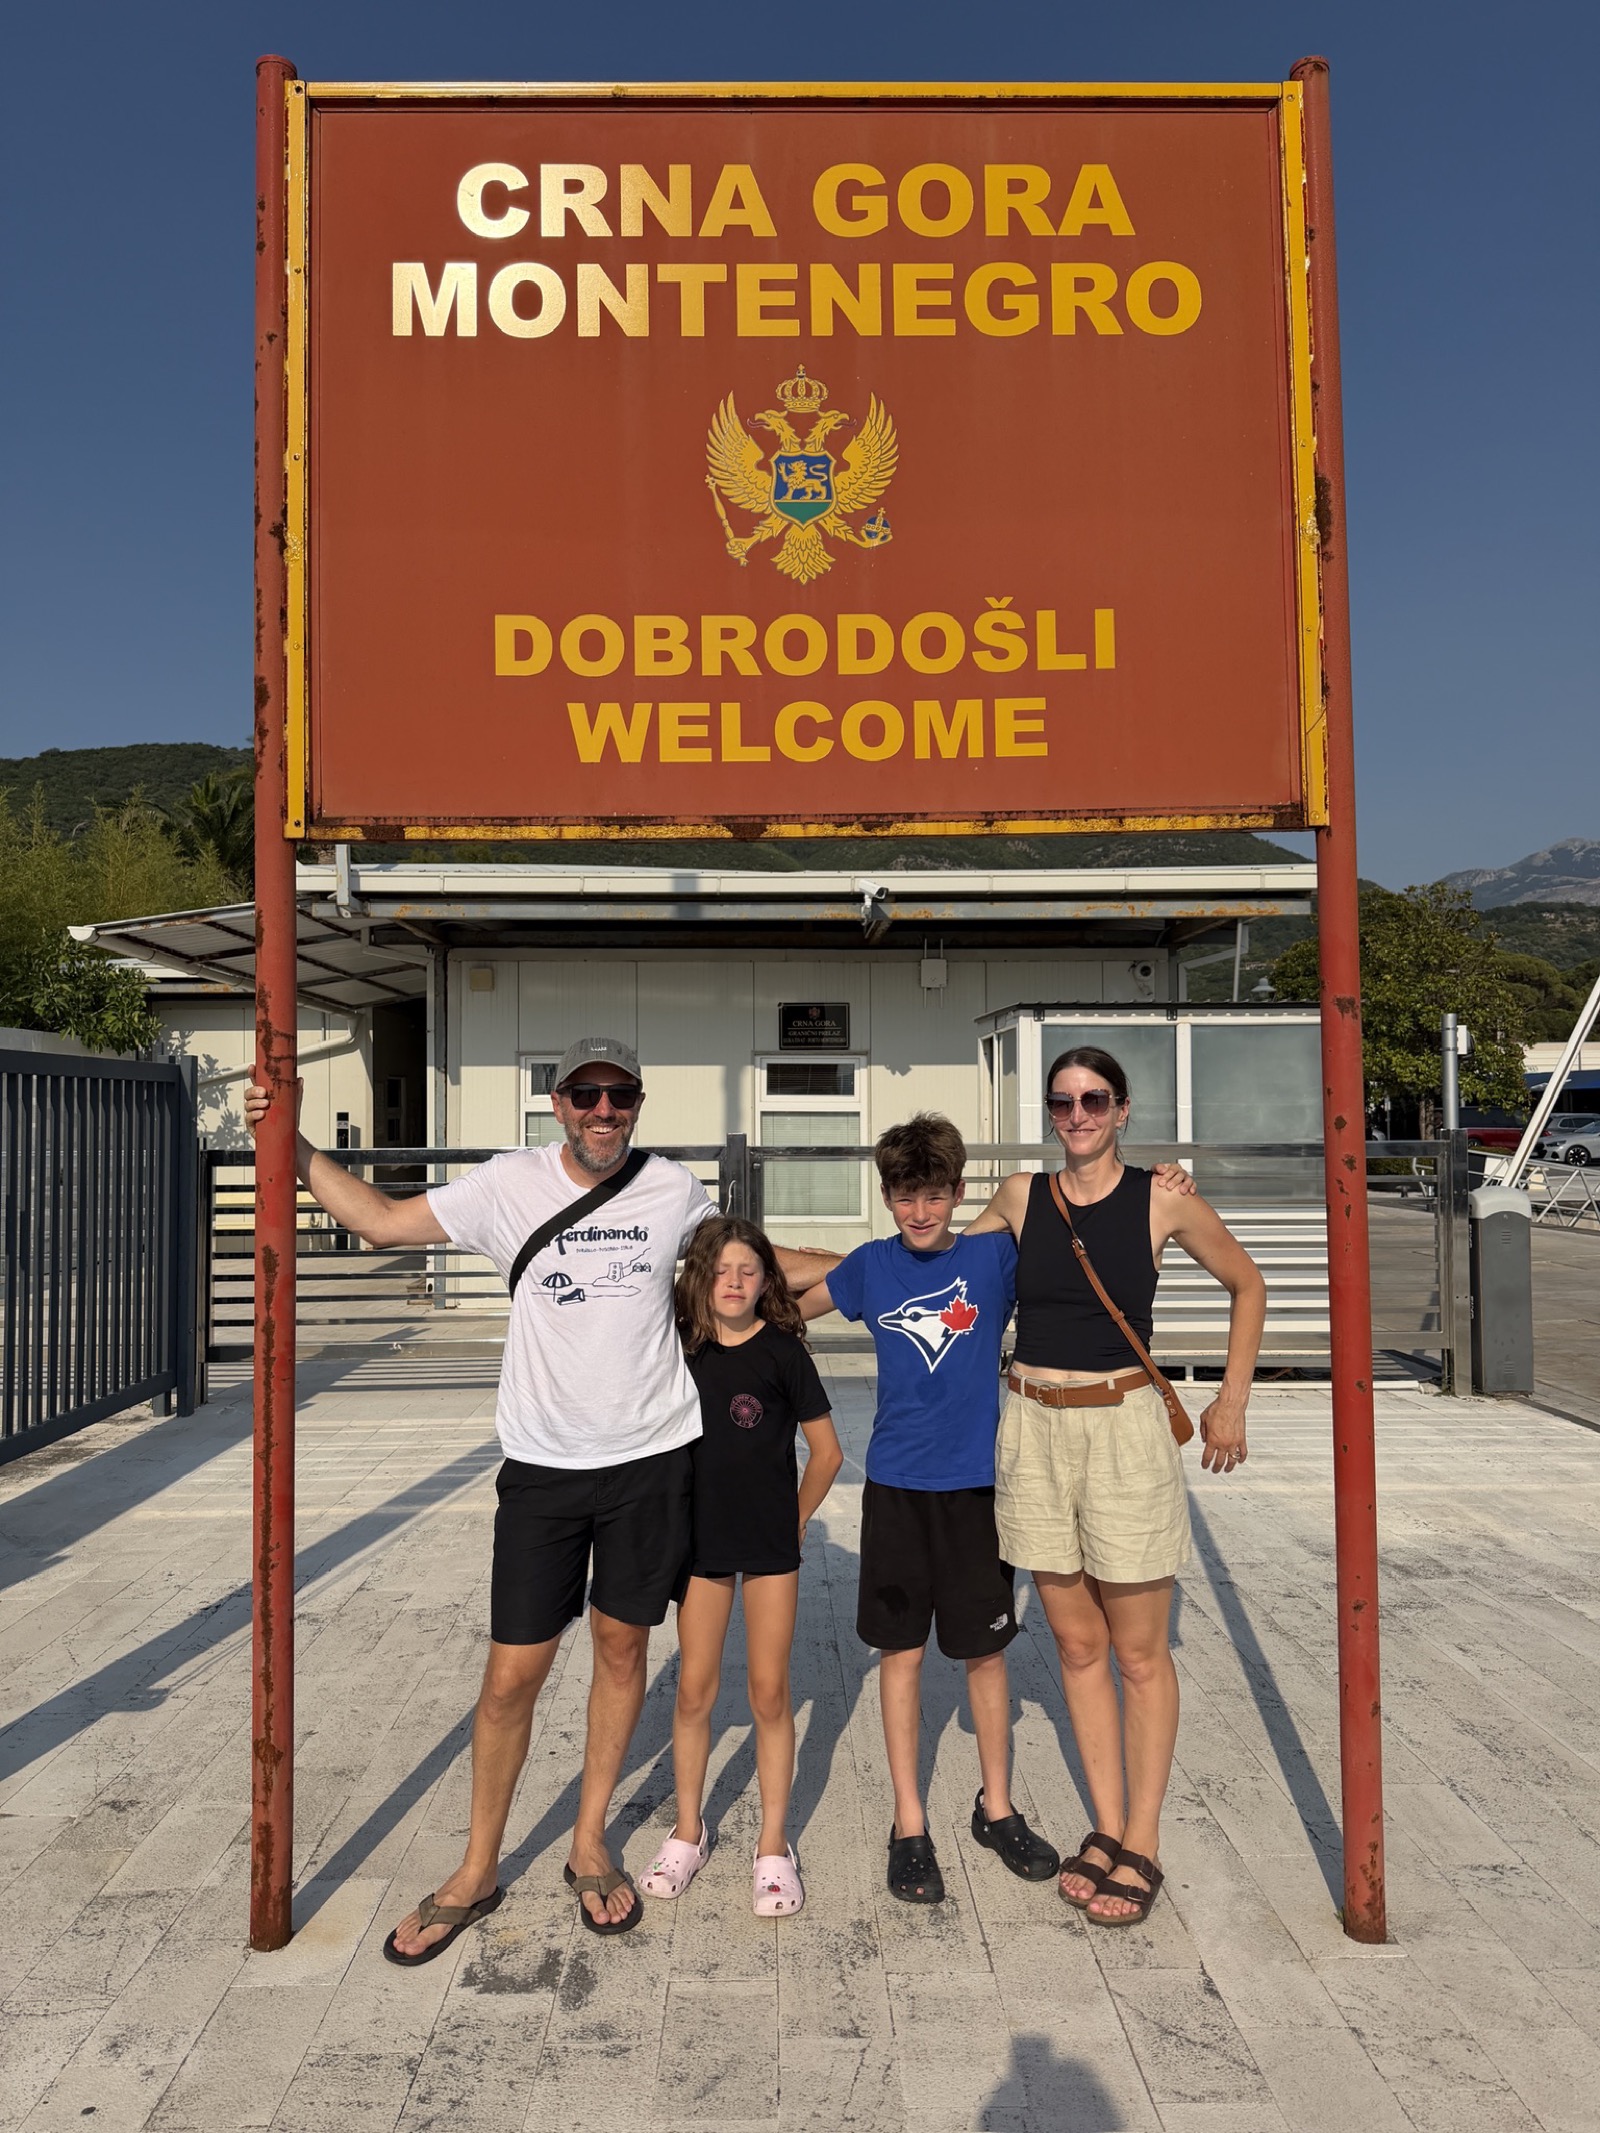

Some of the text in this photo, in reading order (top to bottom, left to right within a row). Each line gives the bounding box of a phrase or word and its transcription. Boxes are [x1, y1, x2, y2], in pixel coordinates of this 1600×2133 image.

[457, 162, 1135, 239] CRNA GORA
[391, 261, 1203, 339] MONTENEGRO
[495, 597, 1116, 677] DOBRODOŠLI
[567, 698, 1048, 763] WELCOME
